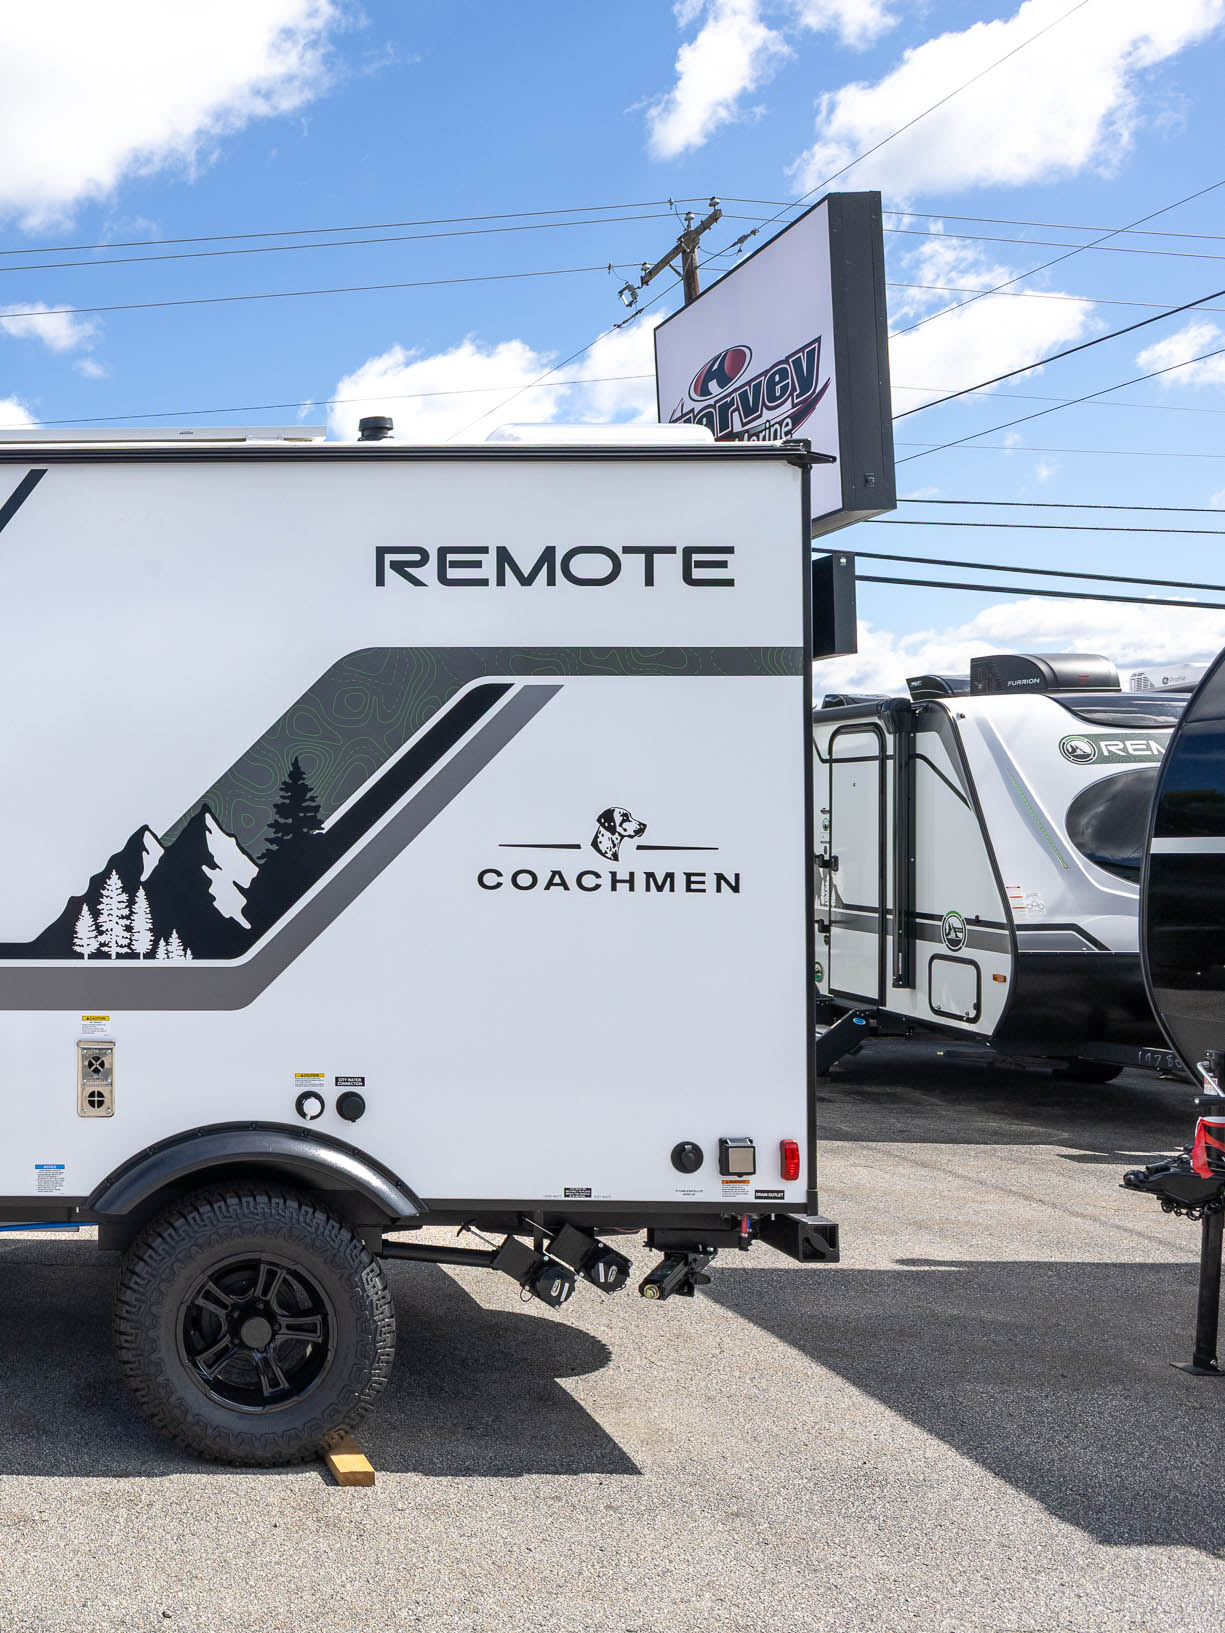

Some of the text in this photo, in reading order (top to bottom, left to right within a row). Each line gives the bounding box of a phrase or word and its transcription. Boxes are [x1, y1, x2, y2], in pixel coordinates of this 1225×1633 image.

[669, 335, 822, 438] arvey
[375, 545, 736, 587] REMOTE
[1007, 678, 1040, 687] FURRION
[476, 868, 741, 894] COACHMEN
